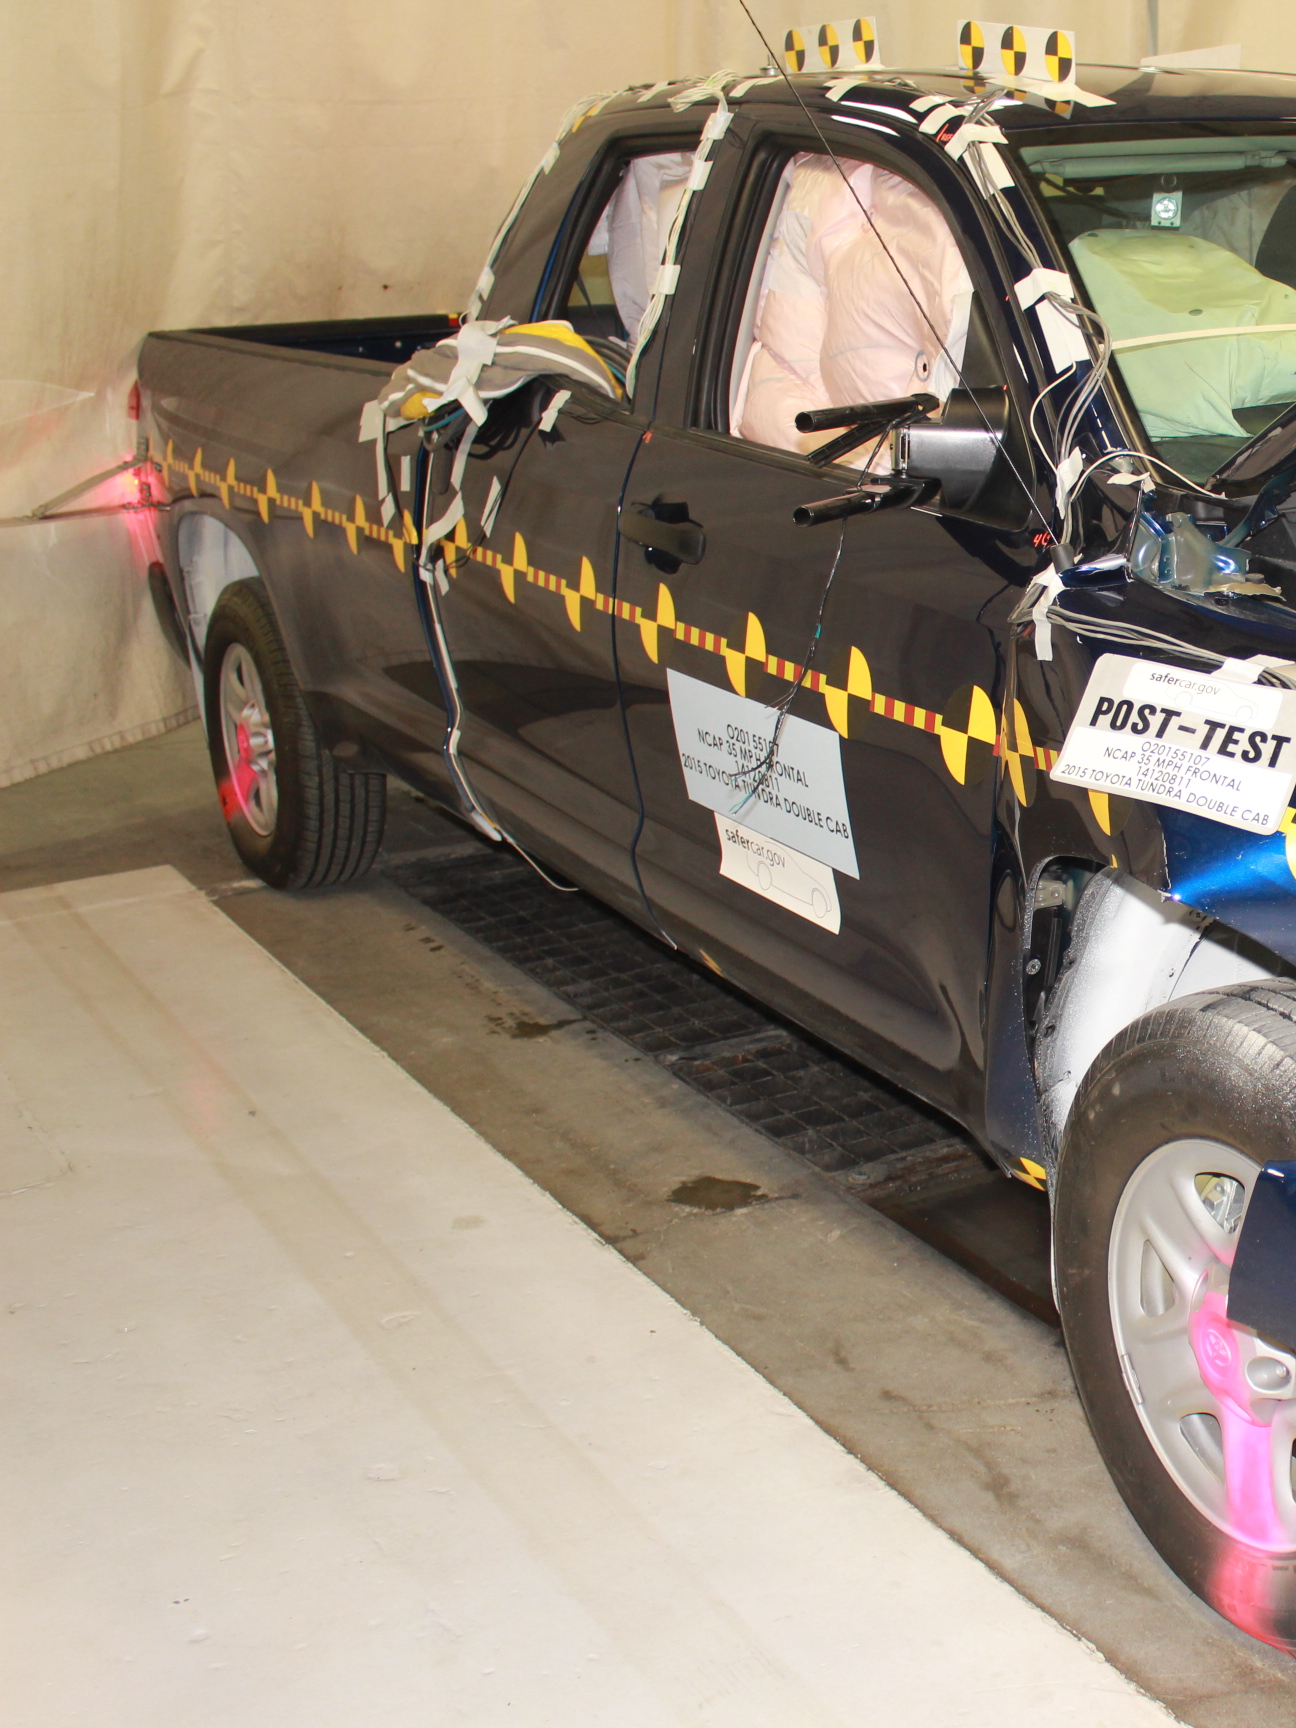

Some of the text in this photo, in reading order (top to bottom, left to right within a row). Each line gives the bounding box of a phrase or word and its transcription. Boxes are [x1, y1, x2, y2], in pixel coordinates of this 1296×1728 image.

[1149, 672, 1220, 695] safercar.gov
[697, 728, 724, 751] NCAP
[726, 740, 738, 758] 35
[739, 745, 763, 768] MPH
[1089, 696, 1292, 768] POST-TEST
[1103, 747, 1242, 792] NCAP 35 MPH FRONTAL
[1136, 766, 1191, 789] 14120811
[682, 753, 849, 839] 2015 TOYOTA TUNDRA DOUBLE CAB
[1061, 764, 1270, 826] 2015 TOYOTA TUNDRA DOUBLE CAB
[725, 828, 786, 868] safercar.gov
